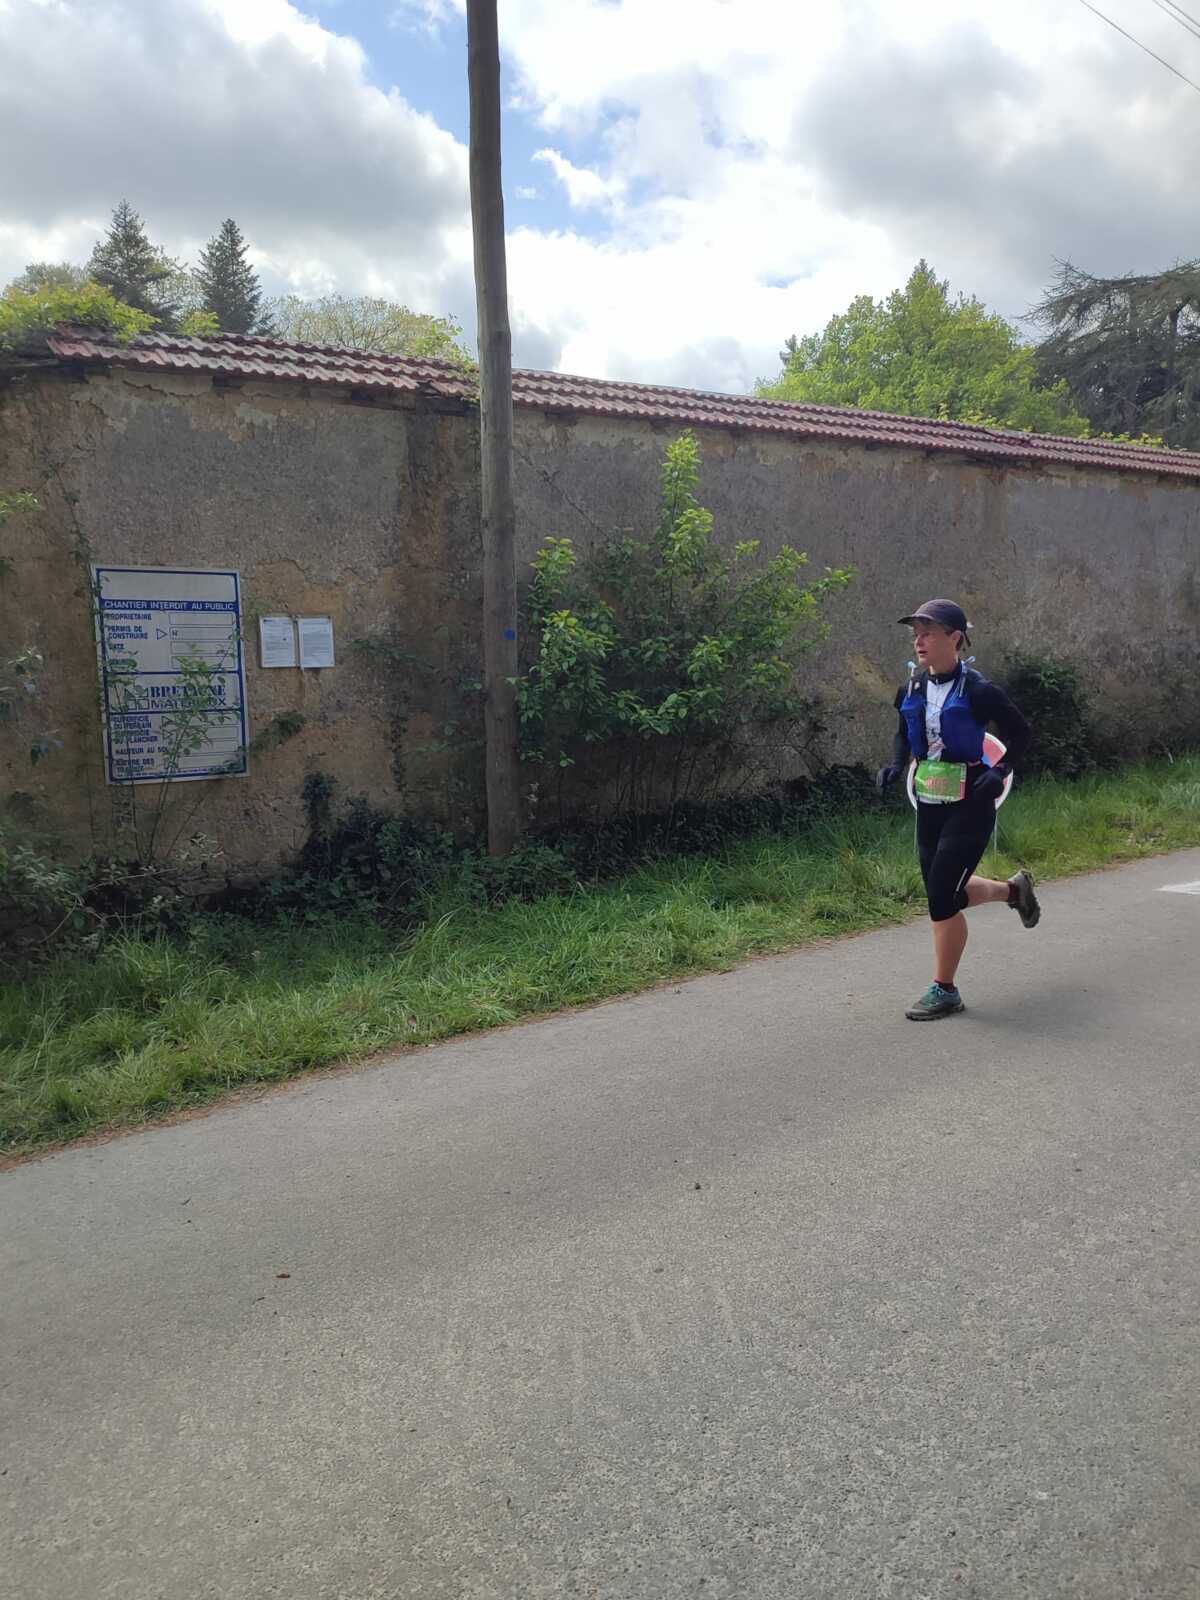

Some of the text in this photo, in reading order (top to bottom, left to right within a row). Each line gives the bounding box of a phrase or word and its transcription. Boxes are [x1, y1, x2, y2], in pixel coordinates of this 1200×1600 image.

[104, 600, 147, 609] CHANTIER
[150, 601, 187, 609] INTERDIT
[205, 602, 234, 610] PUBLIC
[150, 685, 225, 698] BRETANE
